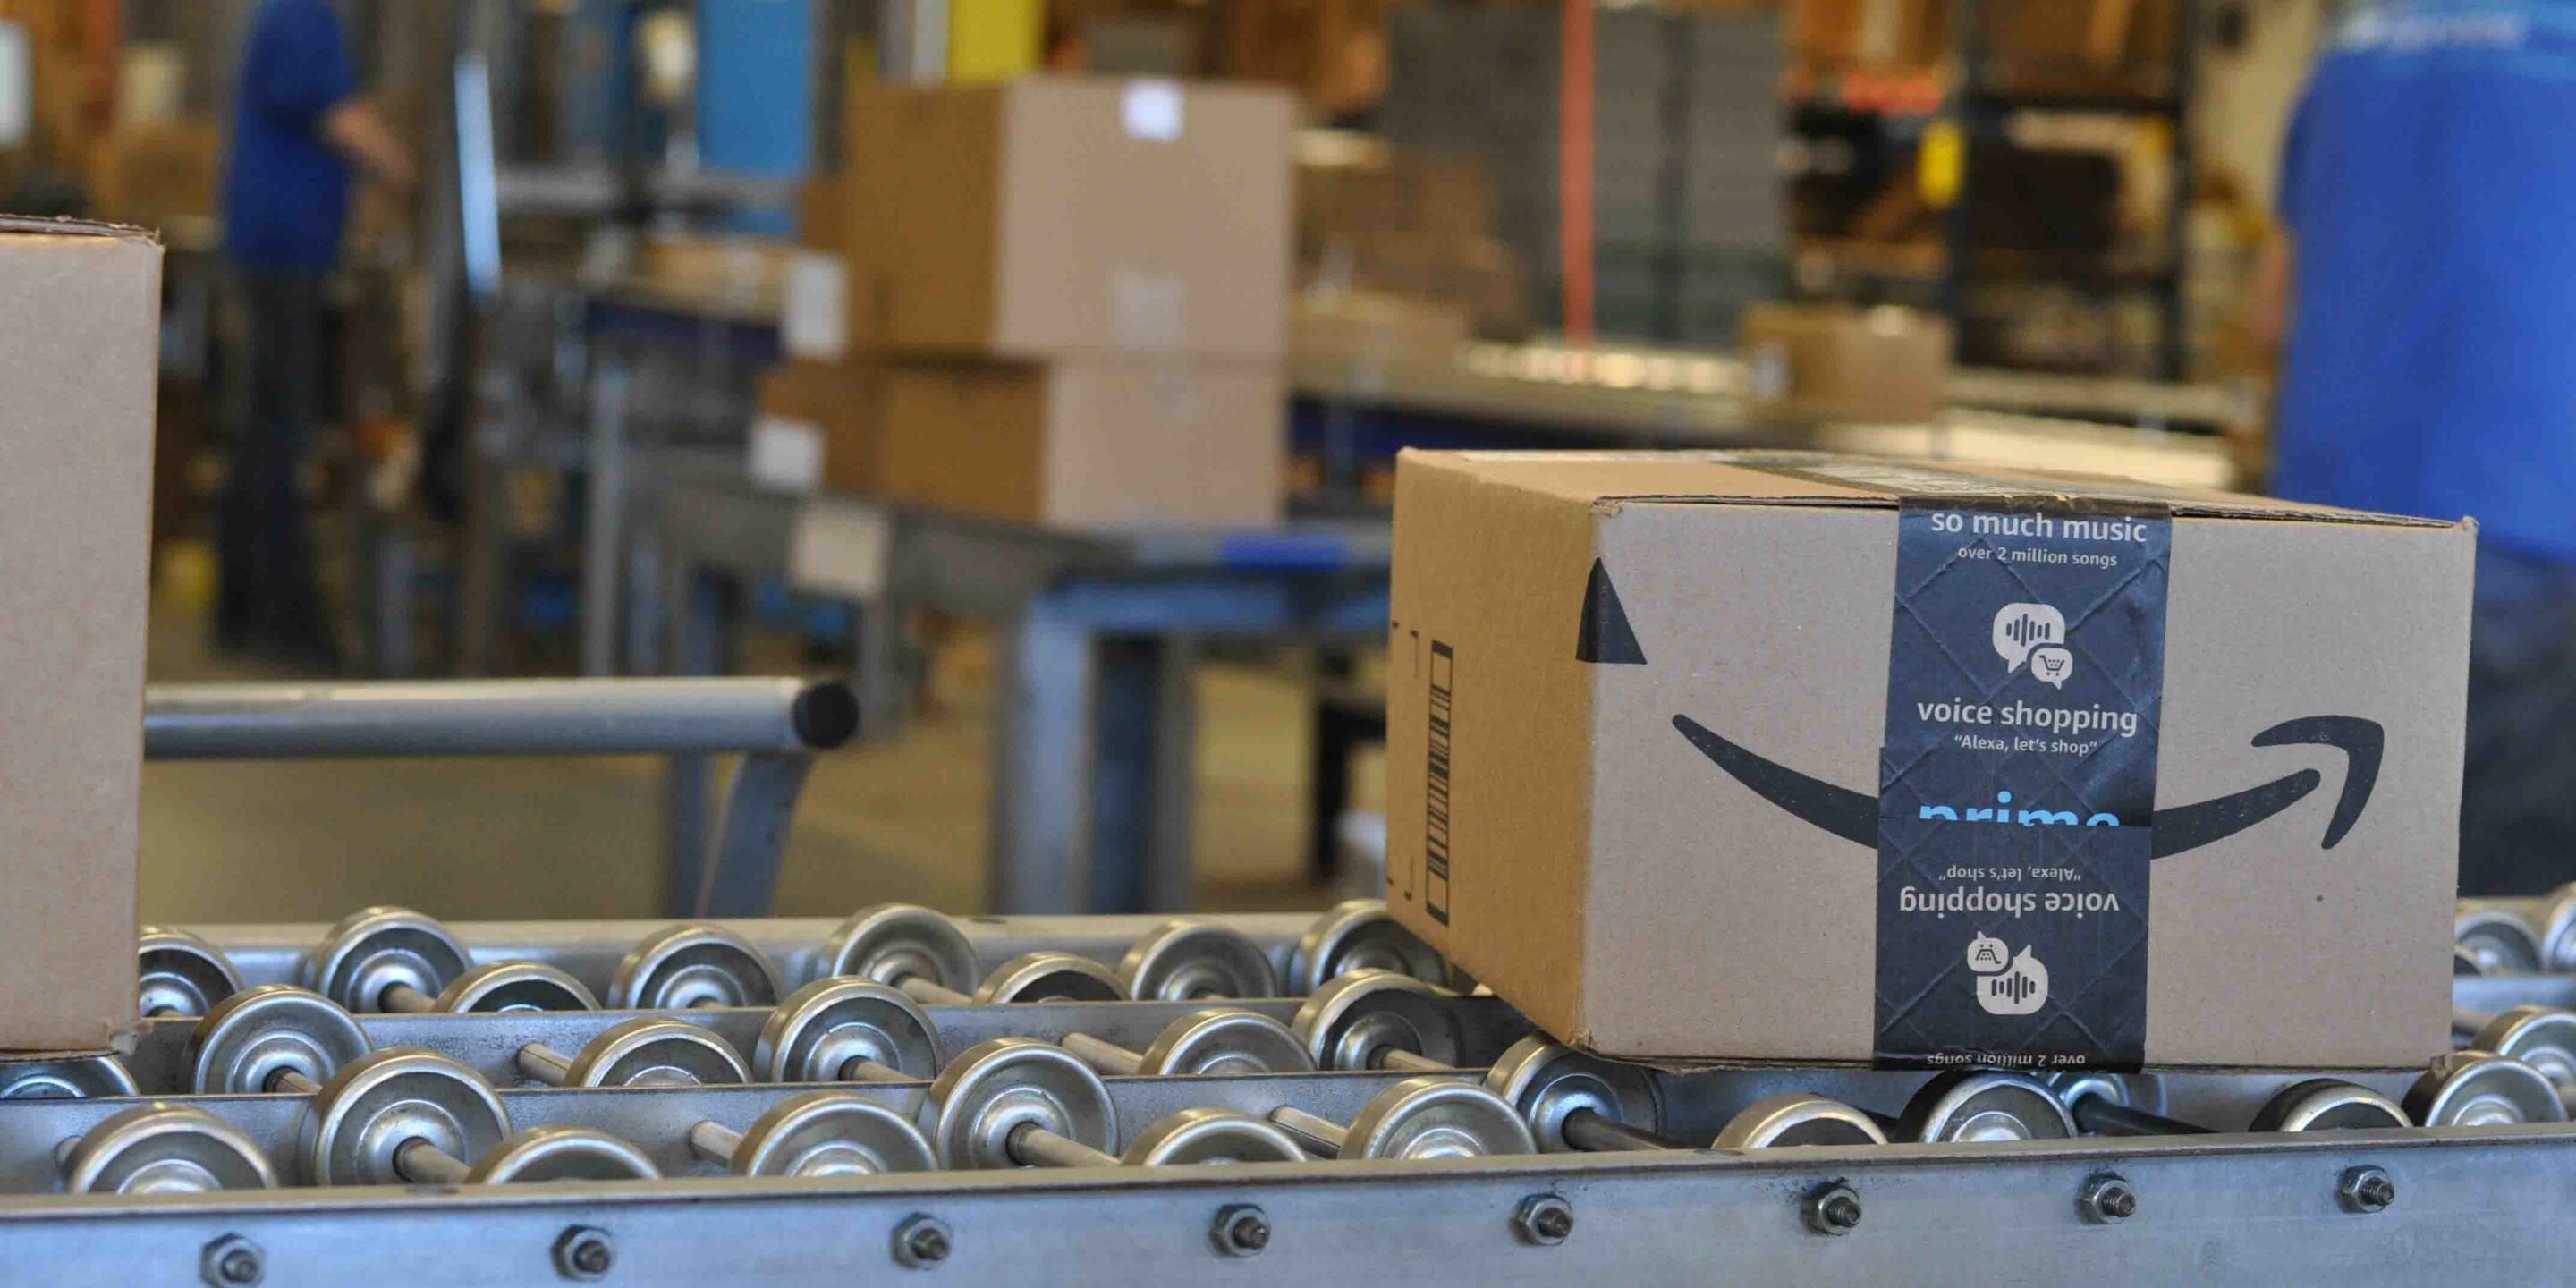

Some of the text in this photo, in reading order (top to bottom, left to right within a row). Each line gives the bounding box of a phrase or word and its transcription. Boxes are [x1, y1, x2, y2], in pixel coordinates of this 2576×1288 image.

[1931, 512, 2148, 543] so much music
[1957, 547, 2118, 570] over 2 million songs
[1917, 696, 2138, 738] voice shopping
[1954, 734, 2098, 758] “Alexa, let’s shop”
[1899, 886, 2121, 919] voice shopping
[1927, 1052, 2086, 1067] over 2 million songs
